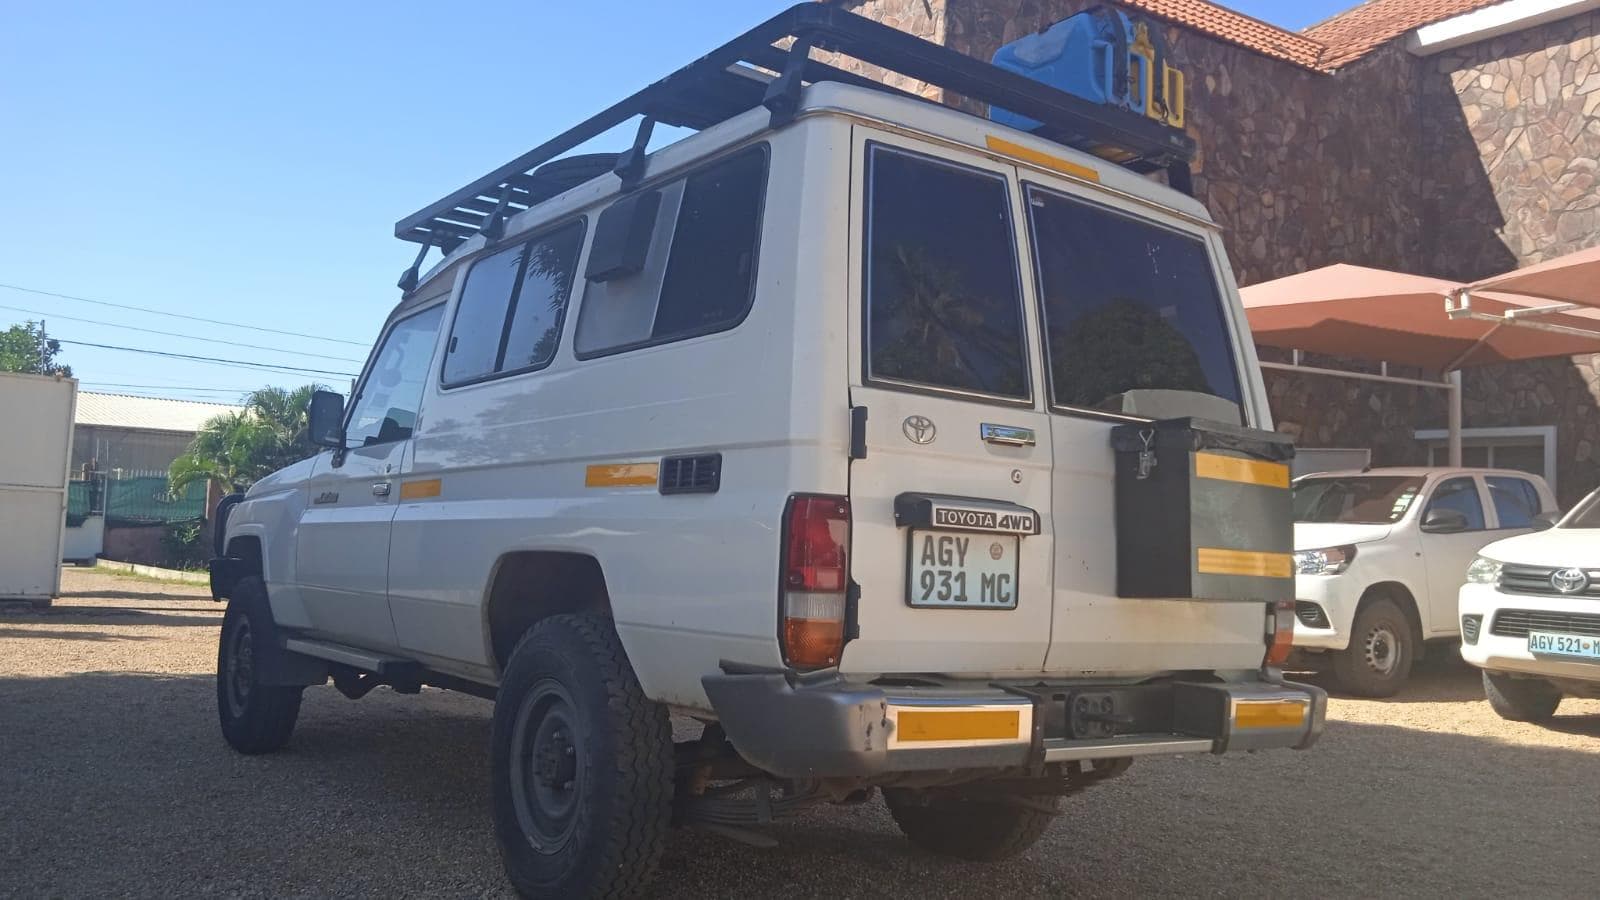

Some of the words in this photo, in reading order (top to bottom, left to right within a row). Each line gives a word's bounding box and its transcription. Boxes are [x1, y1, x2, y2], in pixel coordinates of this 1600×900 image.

[939, 510, 994, 527] TOYOTA
[998, 514, 1033, 531] 4WD
[921, 535, 969, 567] AGY
[920, 570, 967, 602] 931
[981, 573, 1011, 603] MC
[1530, 634, 1554, 651] AGY
[1557, 636, 1581, 653] 521
